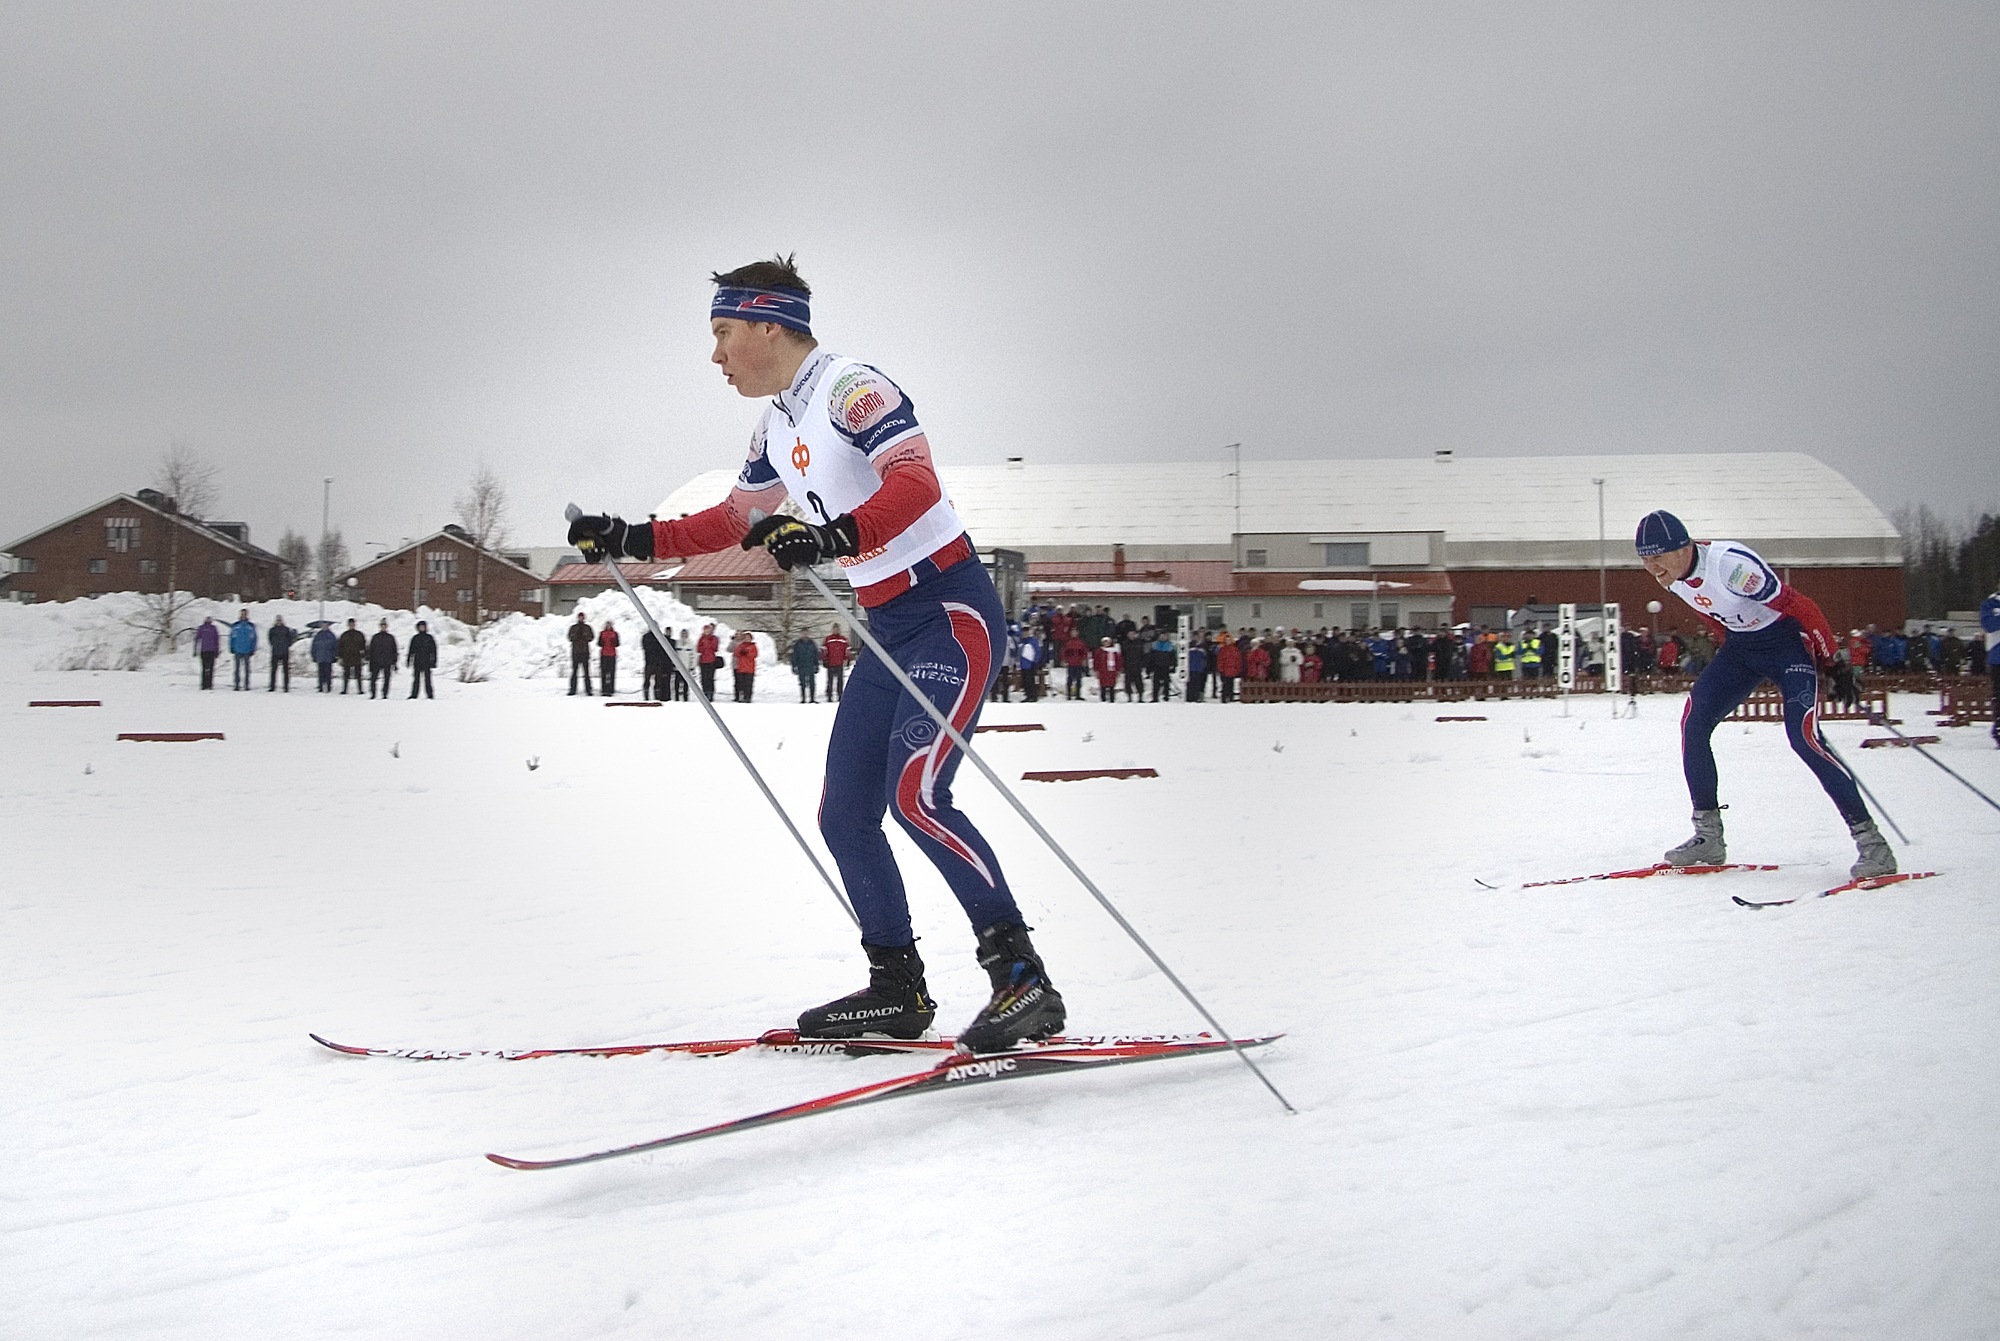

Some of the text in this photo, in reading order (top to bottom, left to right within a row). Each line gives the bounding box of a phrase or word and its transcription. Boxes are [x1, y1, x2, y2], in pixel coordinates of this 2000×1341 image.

[831, 371, 868, 398] PRISMA
[837, 387, 854, 415] Juusto
[864, 418, 907, 449] noname
[825, 1005, 904, 1022] SALOMON
[944, 1057, 1018, 1081] ATOMIC
